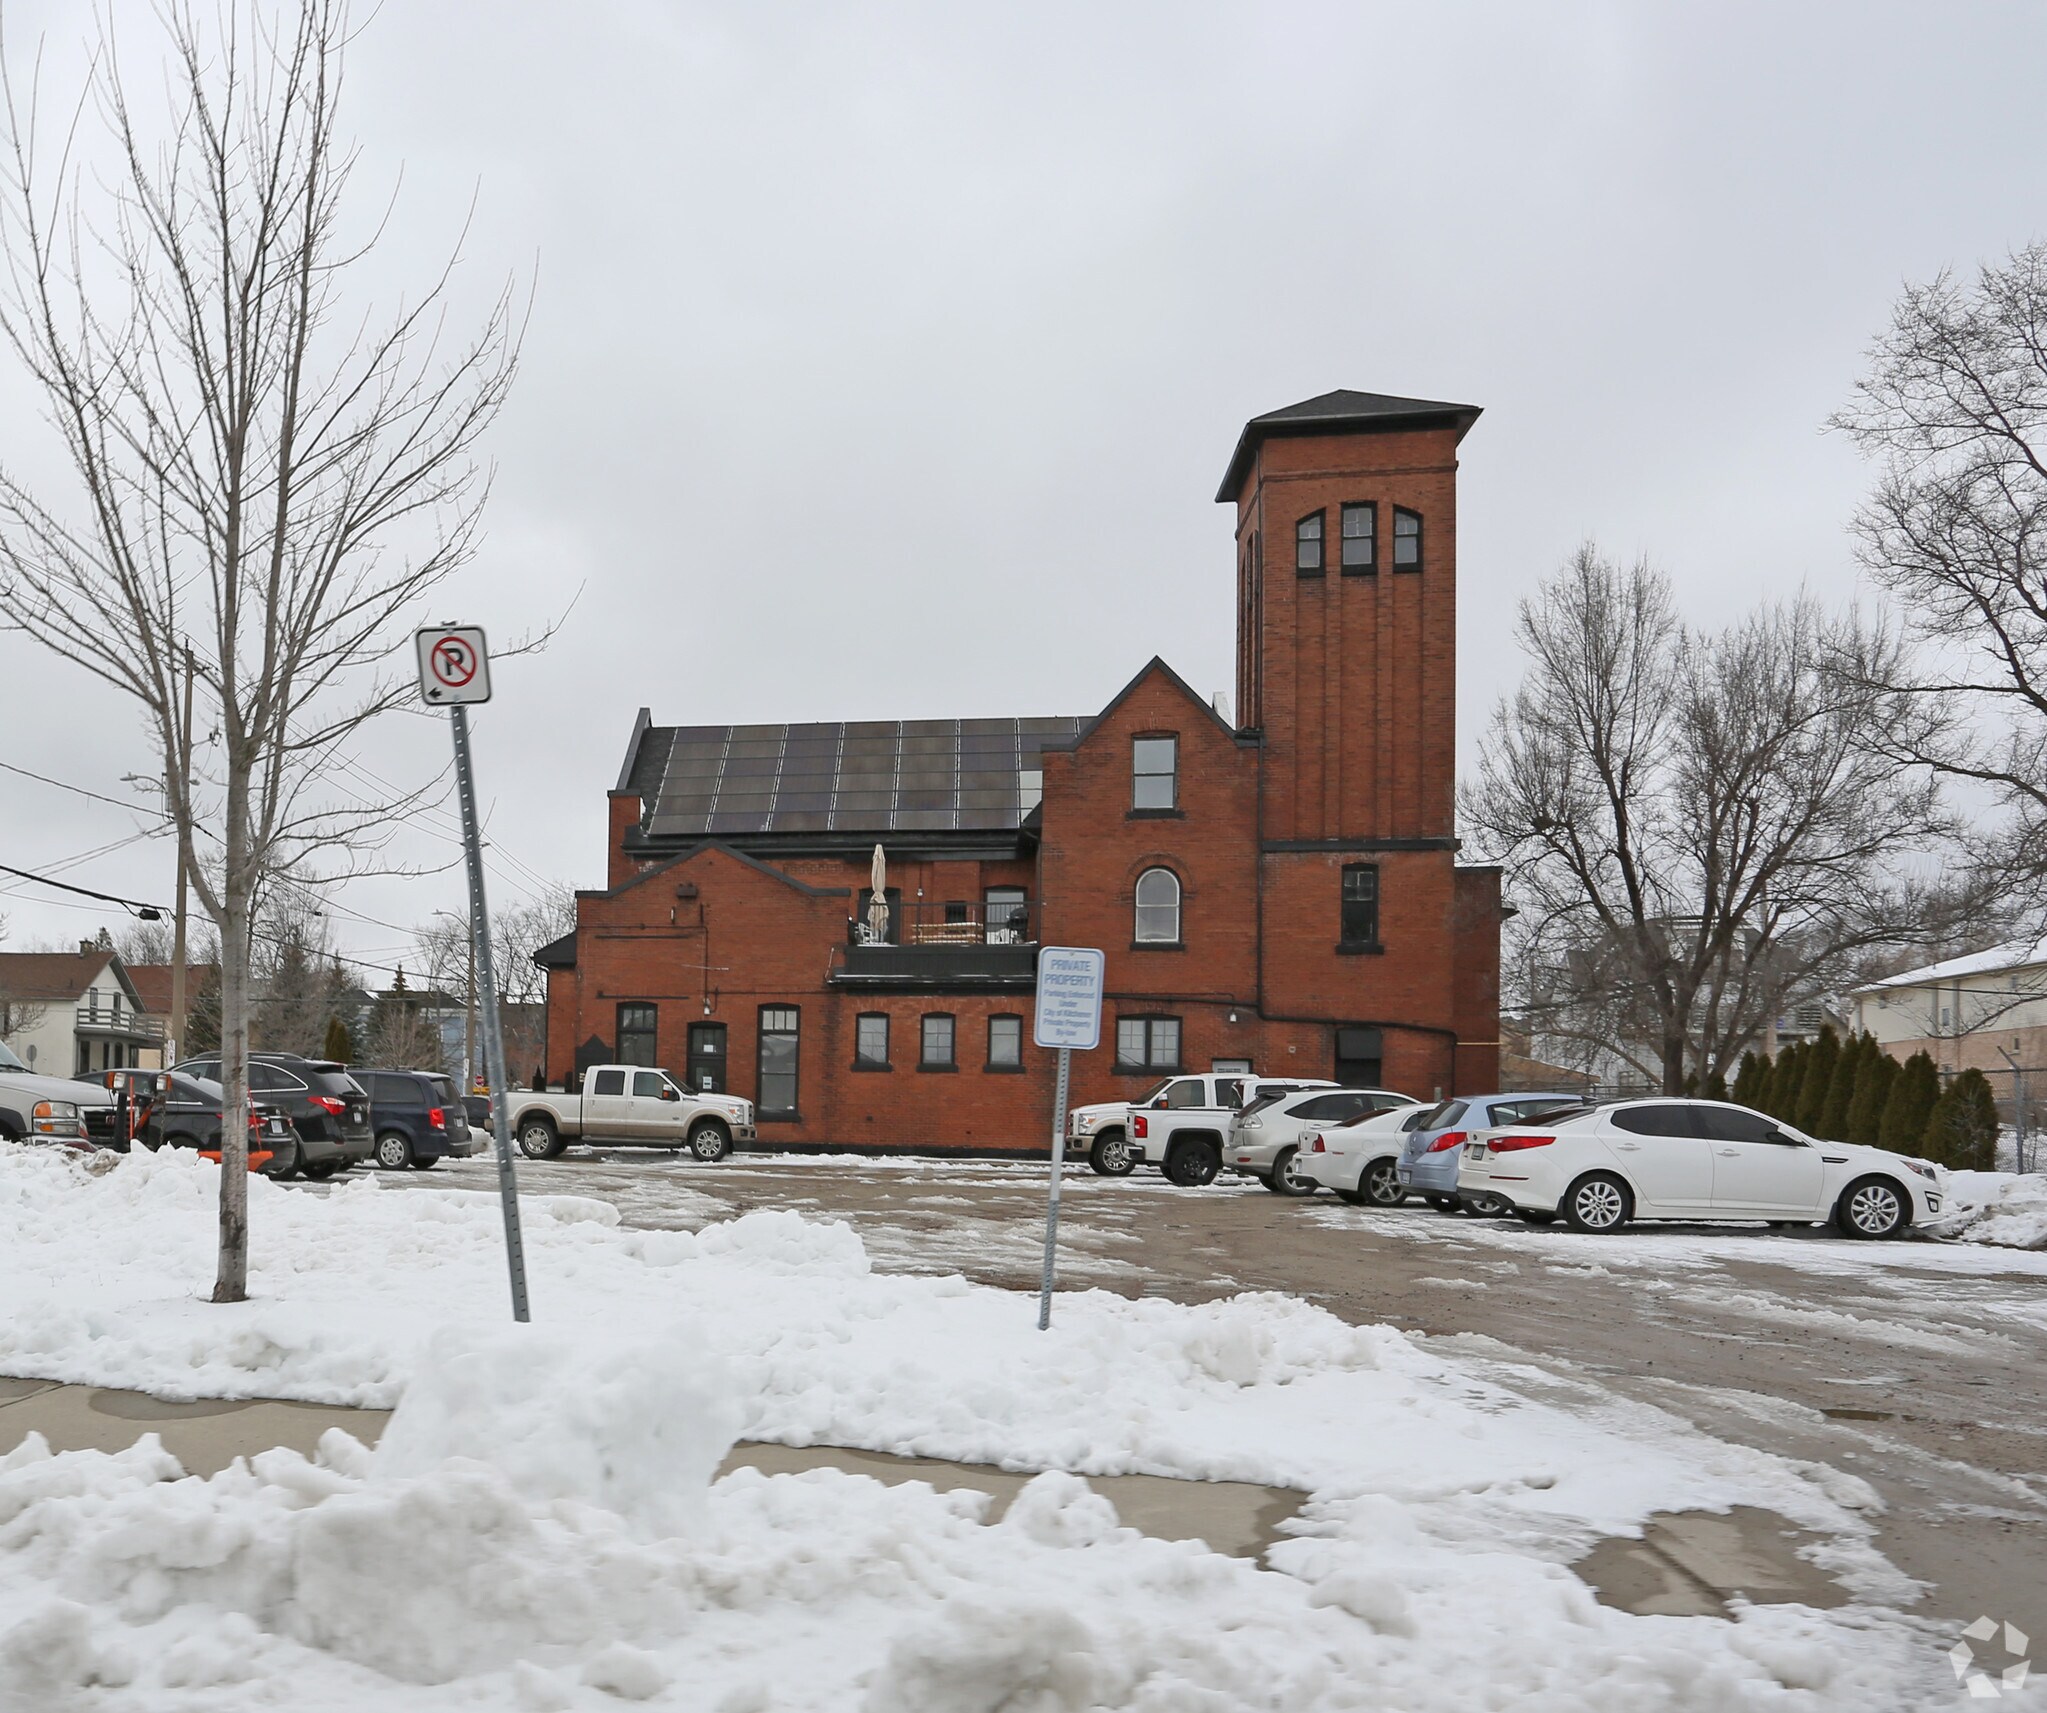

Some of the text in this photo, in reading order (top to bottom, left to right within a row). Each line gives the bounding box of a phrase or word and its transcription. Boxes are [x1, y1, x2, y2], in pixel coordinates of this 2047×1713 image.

[1051, 959, 1092, 972] PRIVATE
[1044, 973, 1096, 987] PROPERTY
[1044, 989, 1095, 999] Parking Enforced
[1044, 1008, 1055, 1016] City
[1064, 1009, 1092, 1018] Kitchener
[1043, 1018, 1091, 1028] Private Property
